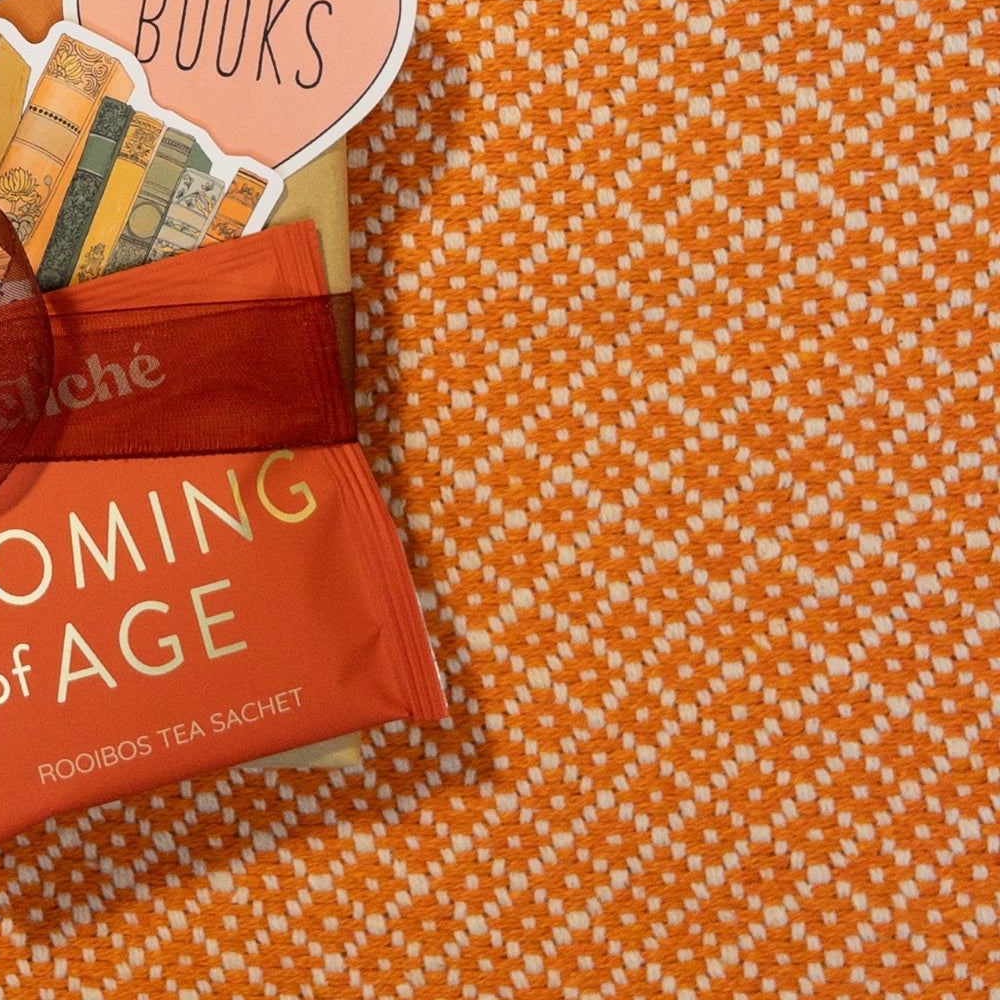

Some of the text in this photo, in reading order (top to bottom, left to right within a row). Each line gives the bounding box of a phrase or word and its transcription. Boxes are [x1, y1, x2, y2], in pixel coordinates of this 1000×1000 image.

[56, 578, 248, 704] AGE
[36, 686, 305, 786] ROOIBOS TEA SACHET
